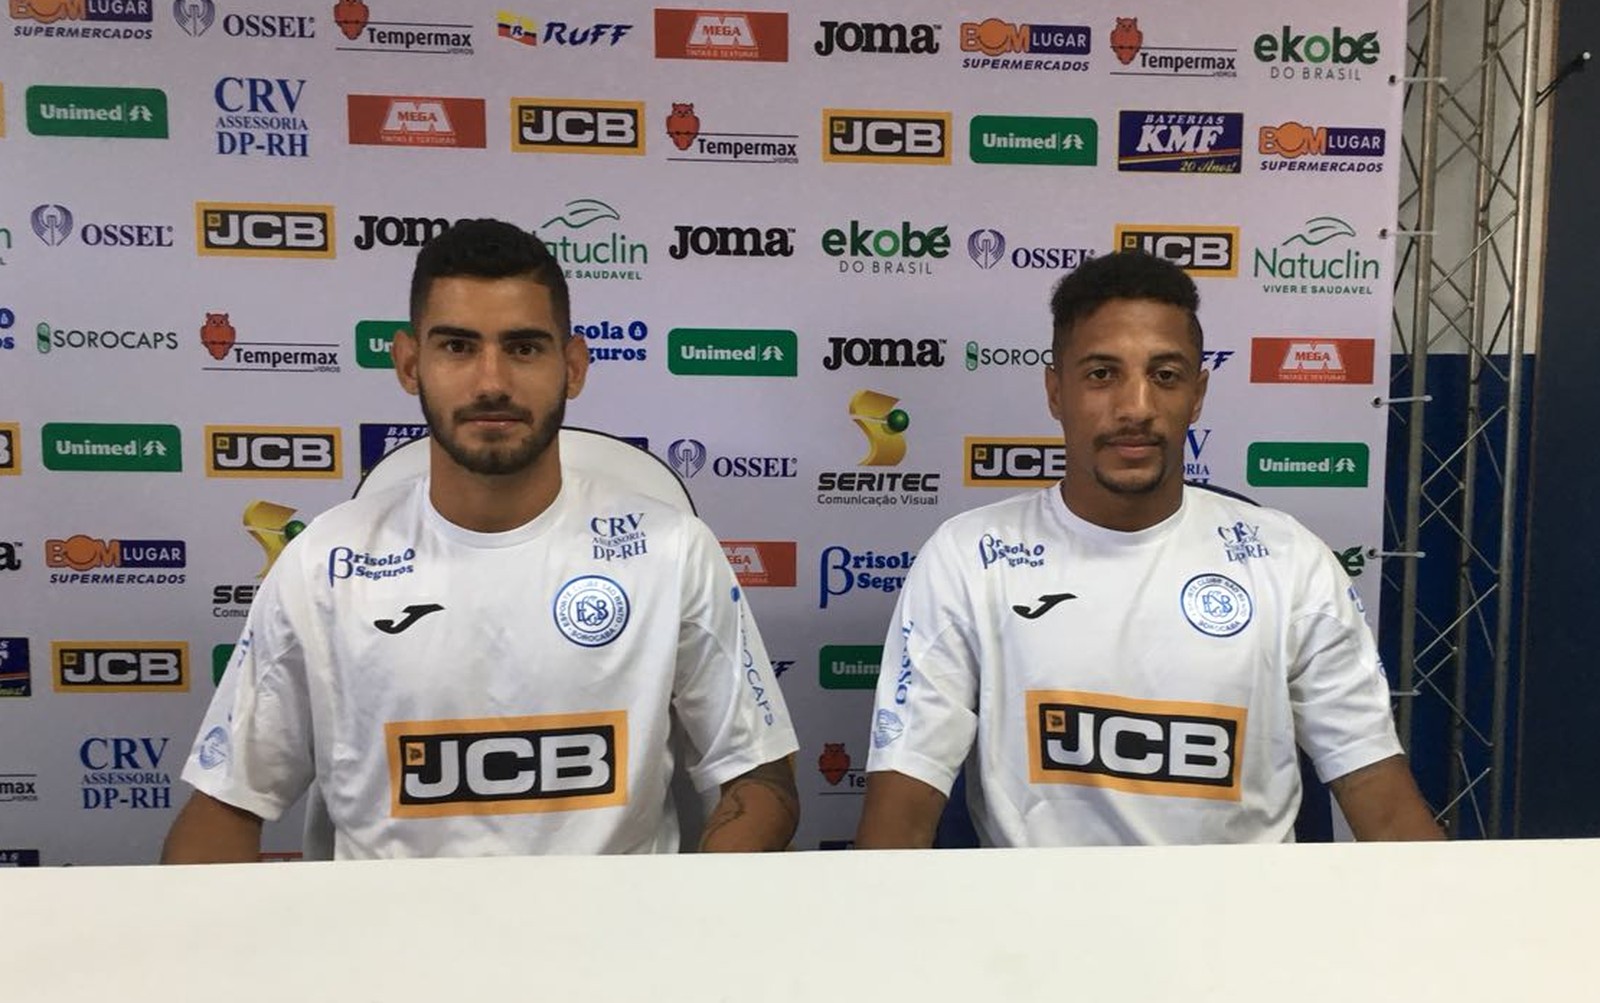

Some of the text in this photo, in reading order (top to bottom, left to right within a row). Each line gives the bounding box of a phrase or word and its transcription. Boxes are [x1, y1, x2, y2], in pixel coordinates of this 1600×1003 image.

[88, 0, 149, 14] LUGAR
[13, 25, 153, 40] SUPERMERCADOS
[367, 27, 472, 48] Tempermax
[702, 25, 741, 36] MEGA
[960, 18, 1087, 57] BOM LUGAR
[1254, 26, 1380, 64] ekobé
[962, 58, 1090, 73] SUPERMERCADOS
[1140, 53, 1236, 72] Tempermax
[1270, 66, 1361, 81] DO BRASIL
[214, 77, 308, 115] CRV
[39, 104, 122, 122] Unimed
[398, 111, 438, 122] MEGA
[1144, 114, 1226, 125] BATERIAS
[215, 116, 308, 132] ASSESSORIA
[522, 110, 636, 144] JCB
[217, 132, 310, 157] DP-RH
[833, 121, 942, 154] JCB
[982, 132, 1057, 150] Unimed
[1136, 124, 1225, 153] KMF
[1258, 121, 1382, 158] BOM LUGAR
[698, 139, 797, 158] Tempermax
[1260, 159, 1383, 173] SUPERMERCADOS
[207, 214, 326, 248] JCB
[354, 215, 449, 250] Jom
[822, 221, 951, 259] ekobé
[839, 261, 933, 275] DO BRASIL
[1254, 248, 1379, 279] Natuclin
[576, 270, 642, 280] SAUDAVEL
[1263, 285, 1372, 295] VIVER E SAUDAVEL
[53, 330, 179, 350] SOROCAPS
[234, 348, 338, 368] Tempermax
[681, 345, 757, 362] Unimed
[980, 347, 1053, 367] SOROC
[1295, 352, 1331, 361] MEGA
[55, 439, 138, 457] Unimed
[216, 436, 332, 469] JCB
[1258, 457, 1330, 473] Unimed
[817, 472, 940, 493] SERITEC
[817, 494, 938, 507] Comunicação Visual
[591, 512, 645, 538] CRV
[45, 534, 121, 571] BOM
[122, 547, 182, 562] LUGAR
[727, 555, 751, 565] EGA
[328, 547, 403, 588] Brisola
[355, 564, 414, 581] Seguros
[49, 573, 187, 585] SUPERMERCADOS
[571, 627, 617, 642] SOROCABA
[64, 652, 180, 683] JCB
[831, 660, 880, 675] Unim
[80, 737, 170, 770] CRV
[1046, 712, 1232, 780] JCB
[404, 732, 612, 799] JCB
[82, 773, 171, 785] ASSESSORIA
[82, 786, 171, 809] DP-RH
